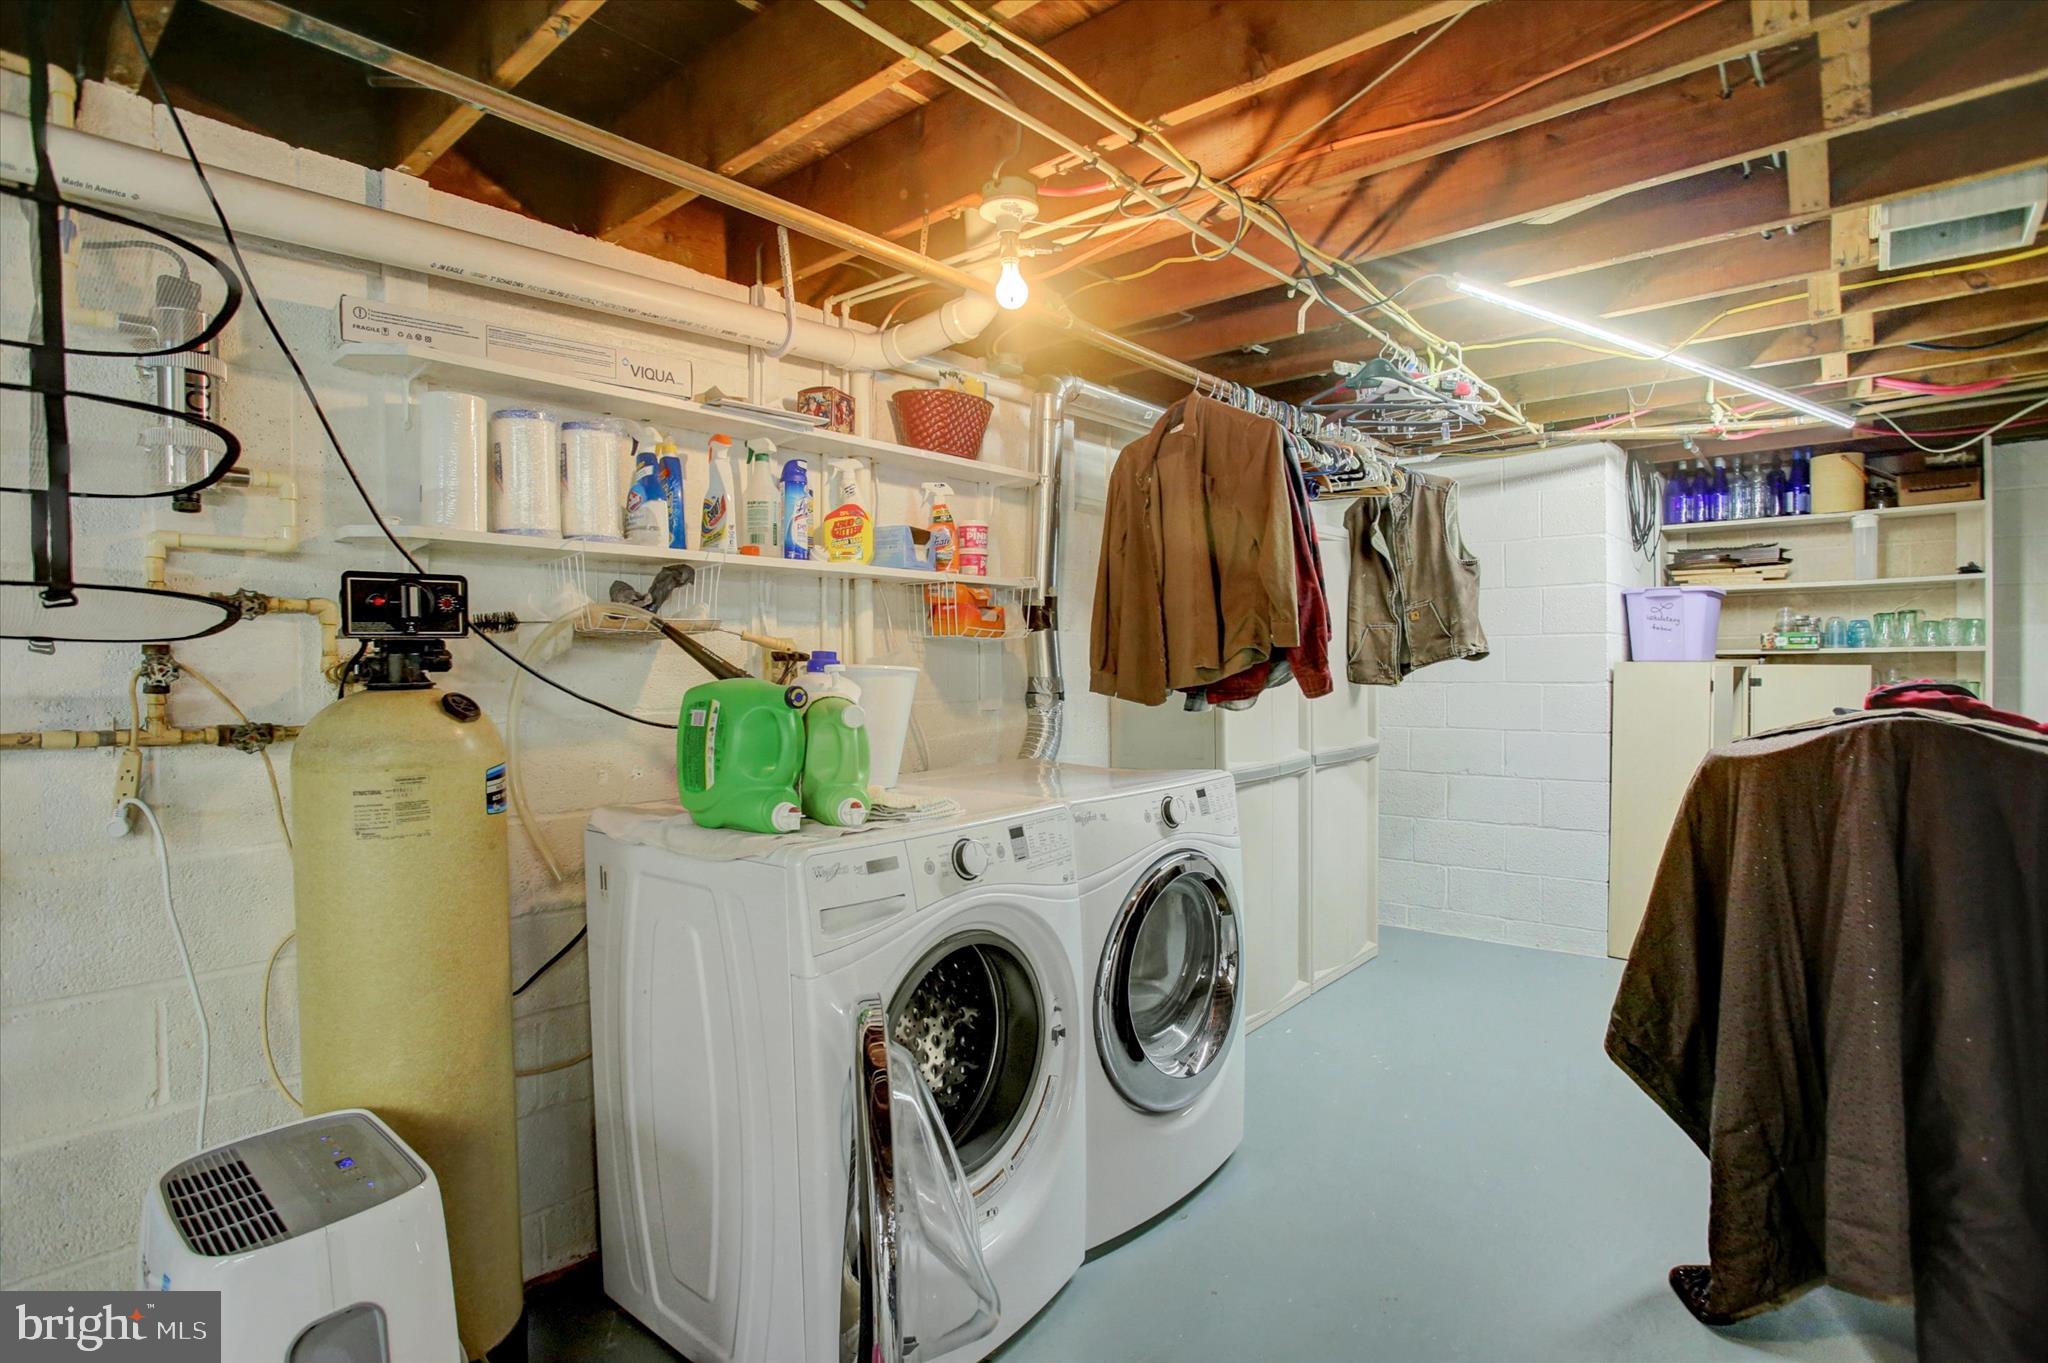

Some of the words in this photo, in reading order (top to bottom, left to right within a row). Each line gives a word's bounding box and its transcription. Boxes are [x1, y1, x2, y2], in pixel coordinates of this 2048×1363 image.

[61, 176, 83, 188] Made
[85, 182, 93, 190] in
[94, 184, 127, 198] America
[446, 265, 464, 275] EAGLE
[352, 323, 381, 334] FRAGILE
[630, 364, 675, 385] VIQUA
